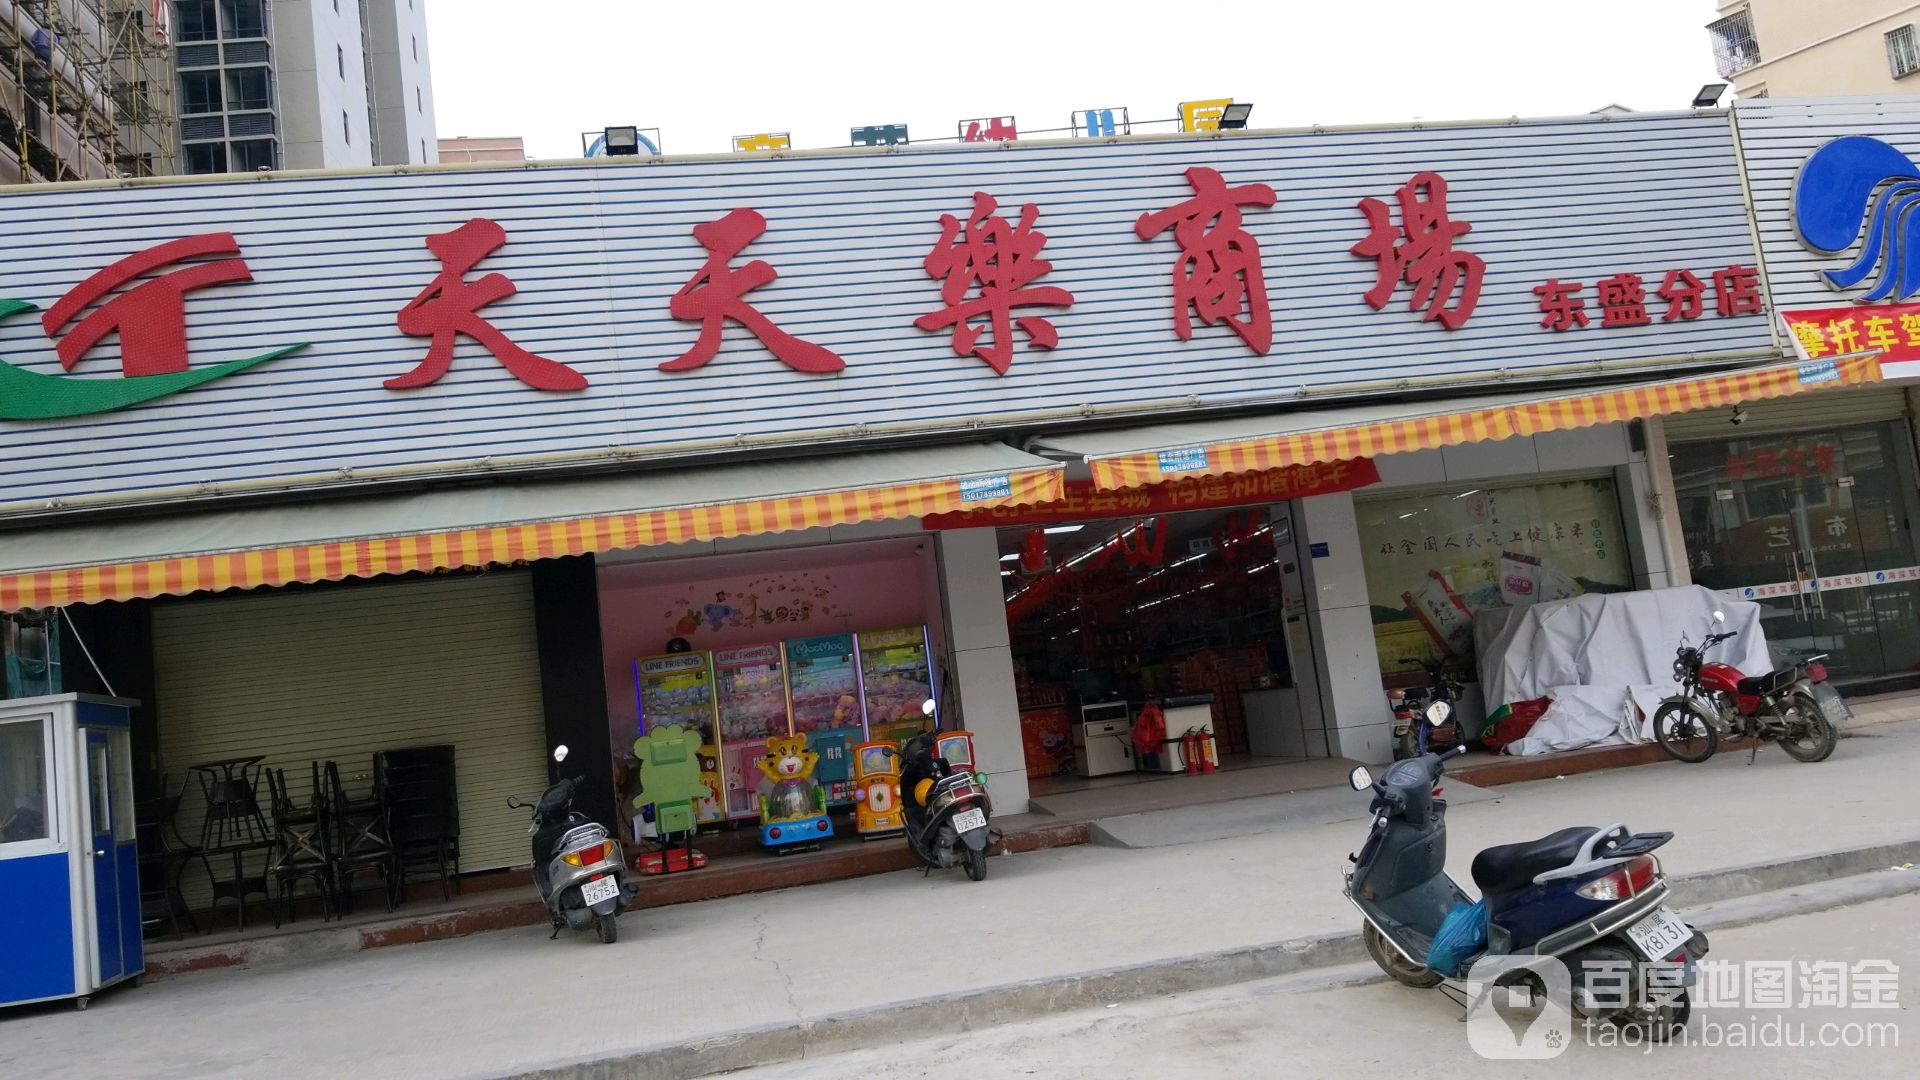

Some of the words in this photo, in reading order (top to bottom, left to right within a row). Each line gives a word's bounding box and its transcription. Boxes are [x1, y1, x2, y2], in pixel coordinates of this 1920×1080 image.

[382, 166, 1487, 392] 天天樂商場
[1532, 263, 1764, 333] 东盛分店
[1790, 312, 1920, 359] 摩托车驾
[1887, 568, 1920, 581] 海深驾
[645, 661, 663, 672] LINE
[664, 656, 699, 669] FRIENDS
[739, 646, 773, 659] FRIENDS
[586, 884, 617, 903] 26752
[1641, 921, 1685, 957] K8131
